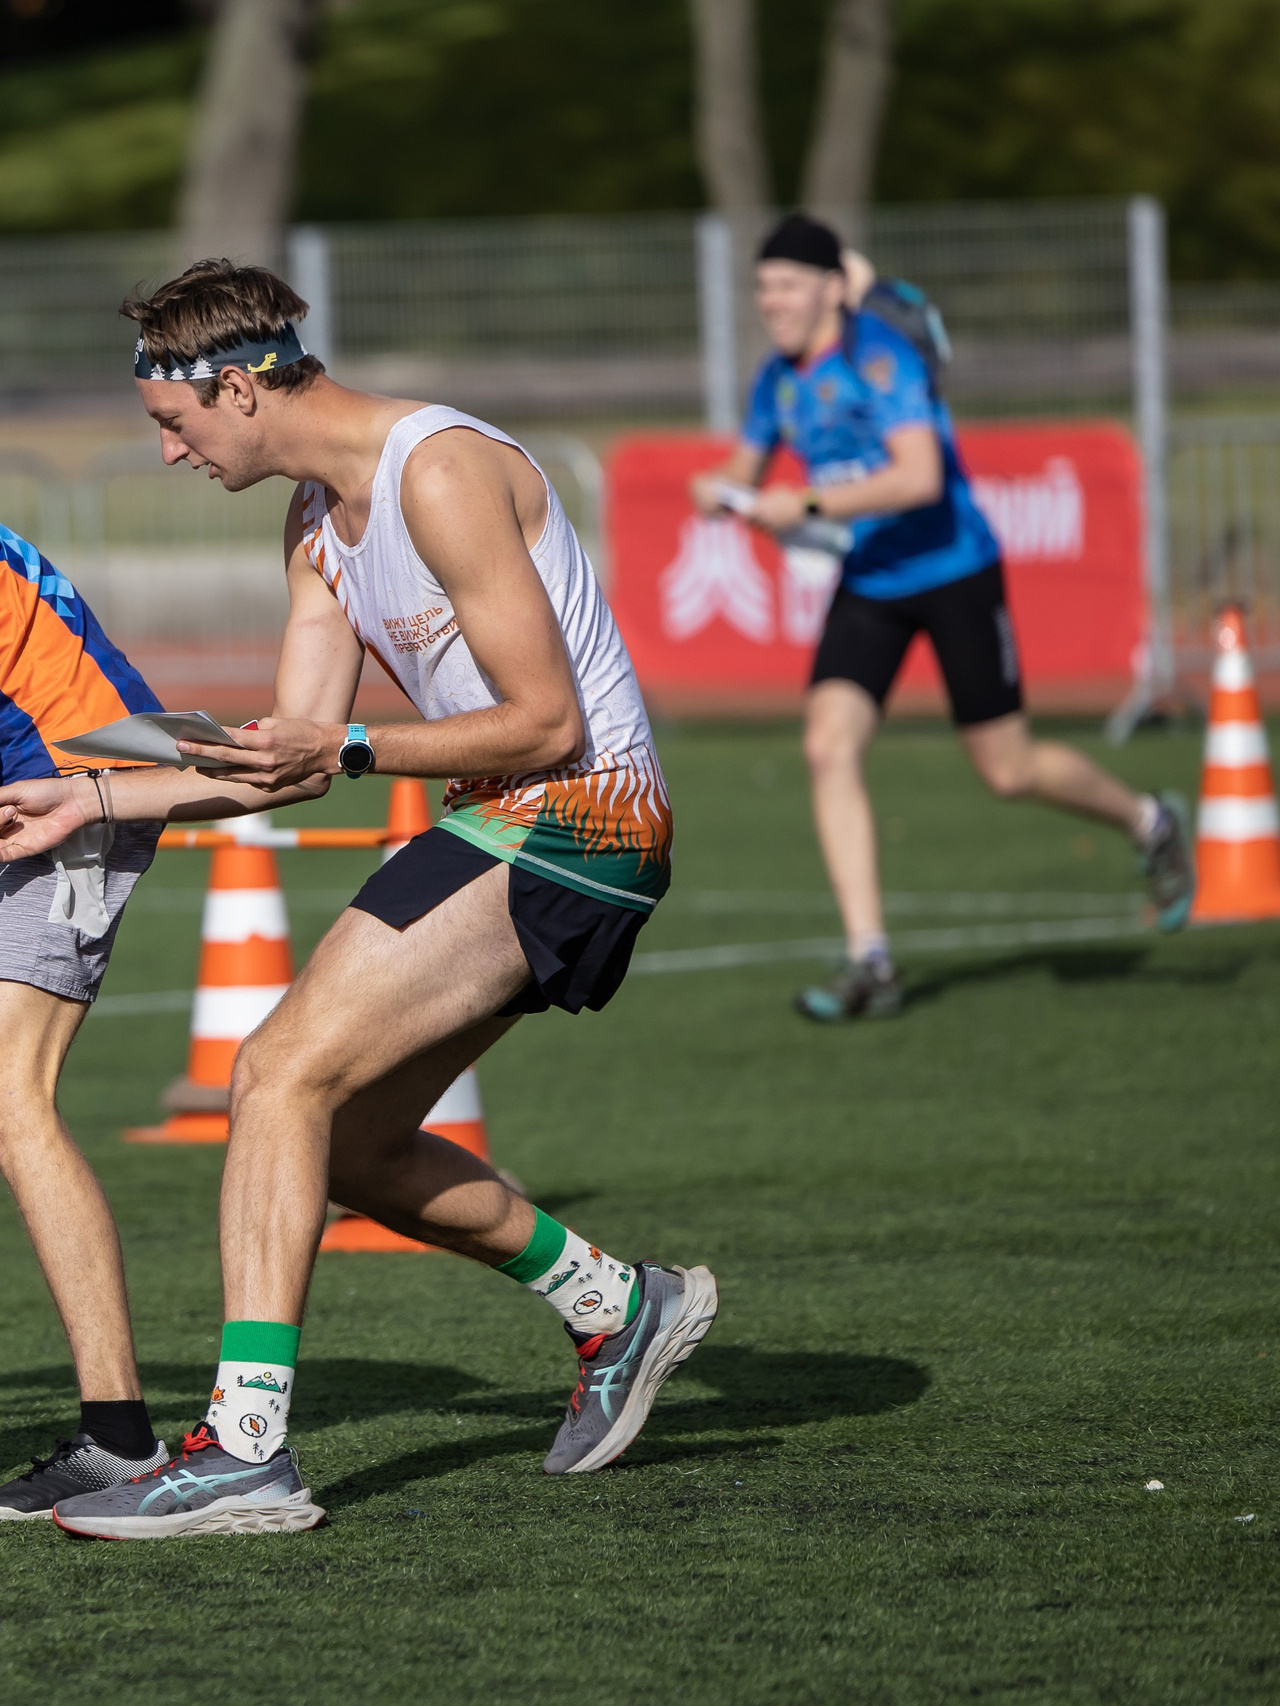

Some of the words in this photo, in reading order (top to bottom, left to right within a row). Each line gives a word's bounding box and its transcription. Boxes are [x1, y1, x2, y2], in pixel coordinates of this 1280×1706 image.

[382, 617, 406, 630] ВИЖУ
[407, 606, 444, 628] ЦЕЛЬ
[387, 630, 400, 643] НЕ
[400, 625, 430, 641] ВИЖУ
[394, 617, 461, 654] ПРЕПЯТСТВИ
